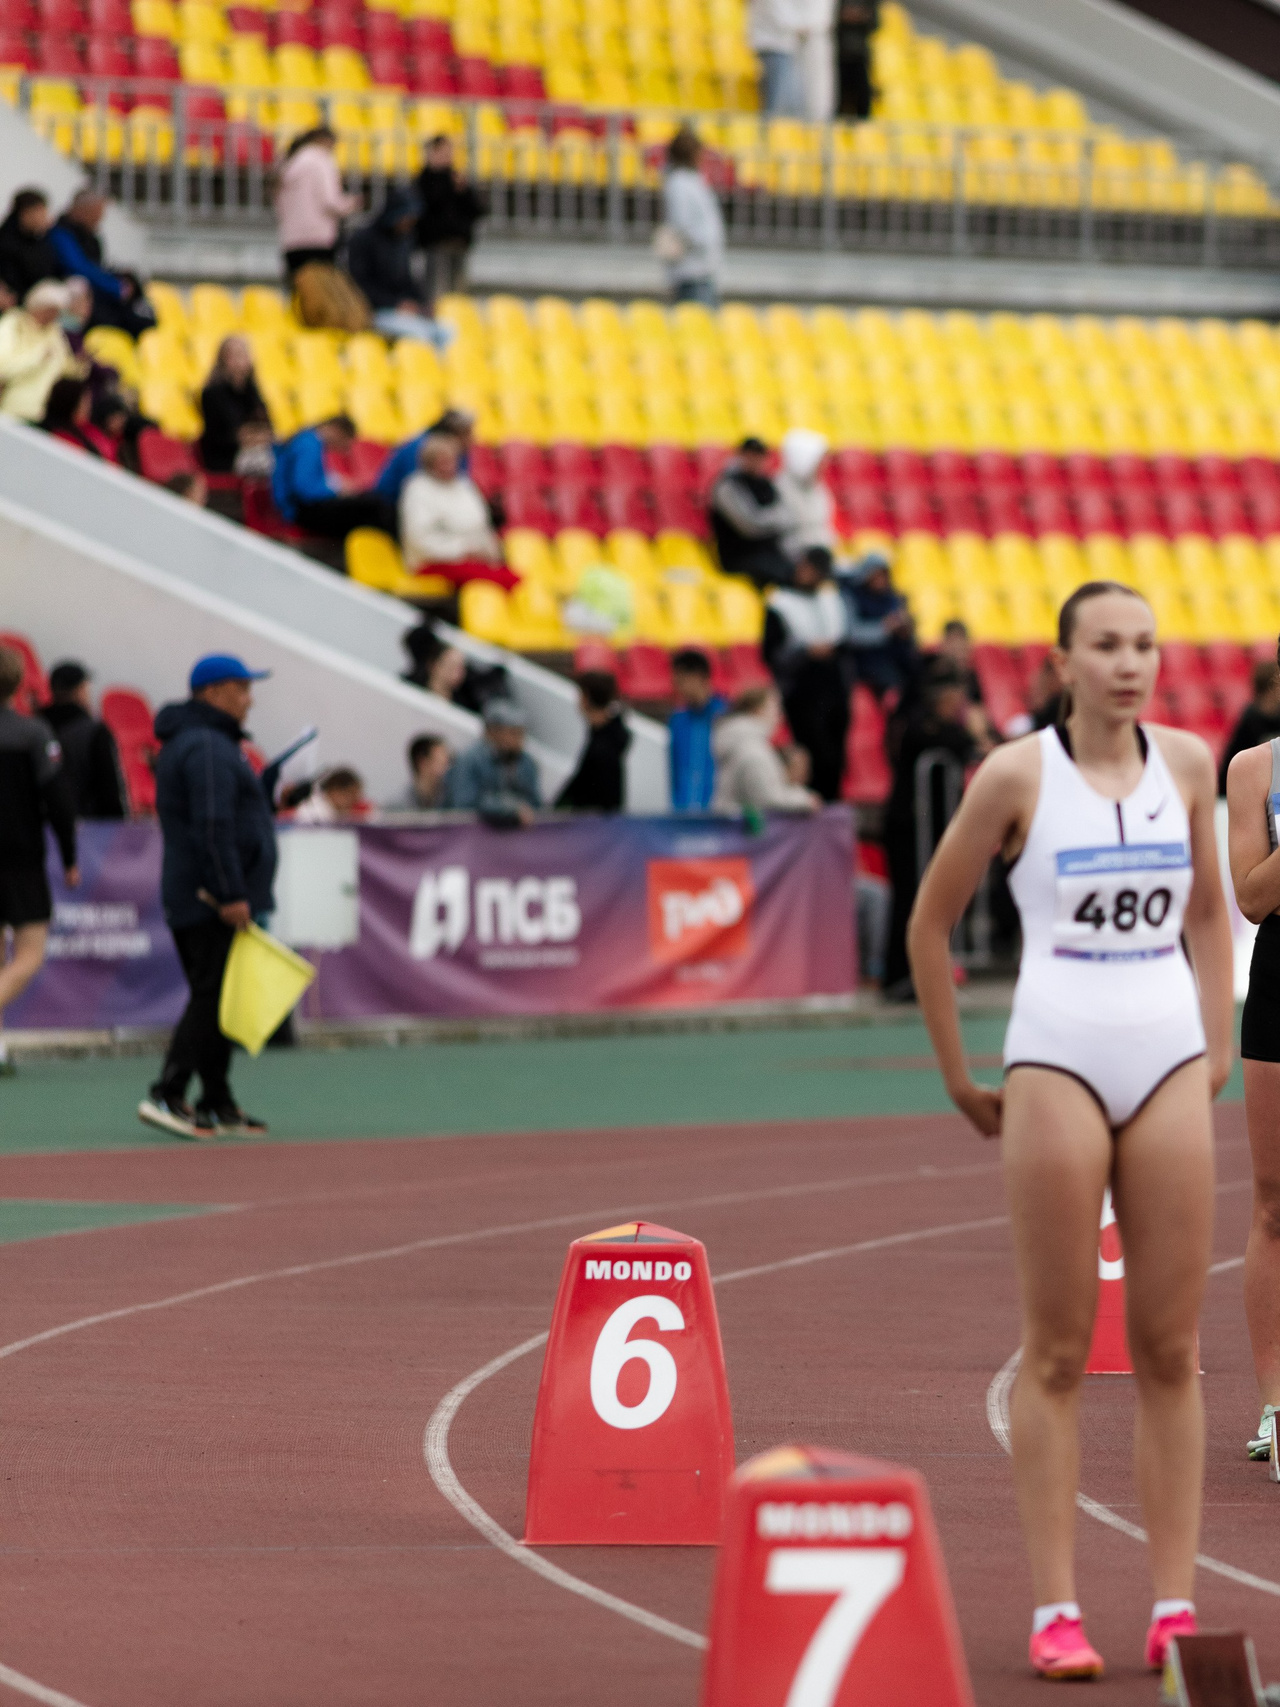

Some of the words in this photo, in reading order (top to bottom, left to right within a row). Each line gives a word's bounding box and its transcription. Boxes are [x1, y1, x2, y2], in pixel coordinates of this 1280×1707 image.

[474, 875, 583, 945] ПСБ
[1073, 886, 1174, 932] 480
[585, 1259, 692, 1282] MONDO
[589, 1294, 686, 1430] 6
[763, 1546, 908, 1707] 7
